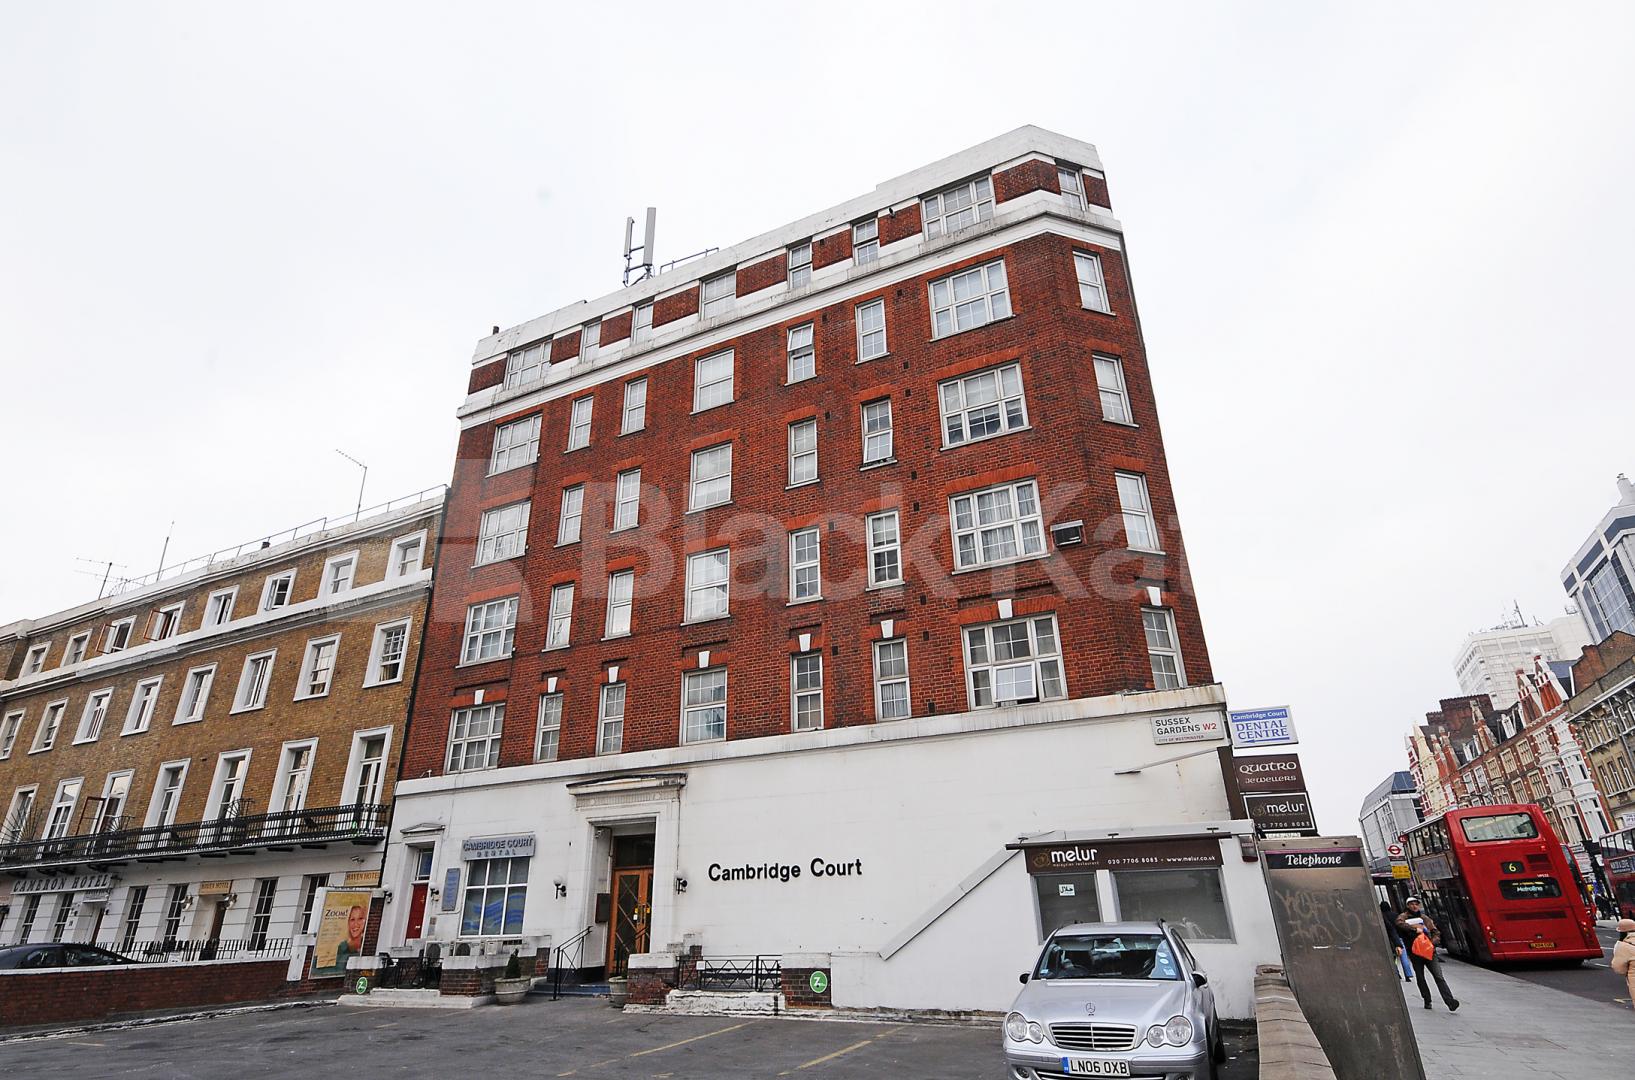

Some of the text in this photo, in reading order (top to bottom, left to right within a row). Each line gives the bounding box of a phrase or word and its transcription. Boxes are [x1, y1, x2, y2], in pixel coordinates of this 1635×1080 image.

[1155, 716, 1192, 727] SUSSEX
[1232, 712, 1266, 720] Cambridge
[1156, 722, 1217, 735] GARDENS W2
[1236, 720, 1287, 732] DENTAL
[1238, 728, 1289, 740] CENTRE
[1266, 801, 1305, 814] melur
[463, 838, 533, 852] CAMBRIDGE COURT
[476, 849, 516, 857] DENTAL
[1050, 846, 1098, 863] melur
[1285, 853, 1342, 867] Telephone
[708, 857, 863, 883] Cambridge Court
[1508, 863, 1517, 872] 6
[363, 872, 380, 880] HOTE
[13, 874, 109, 892] CAMERON HOTEL
[1070, 1059, 1128, 1074] LN06 OXB
